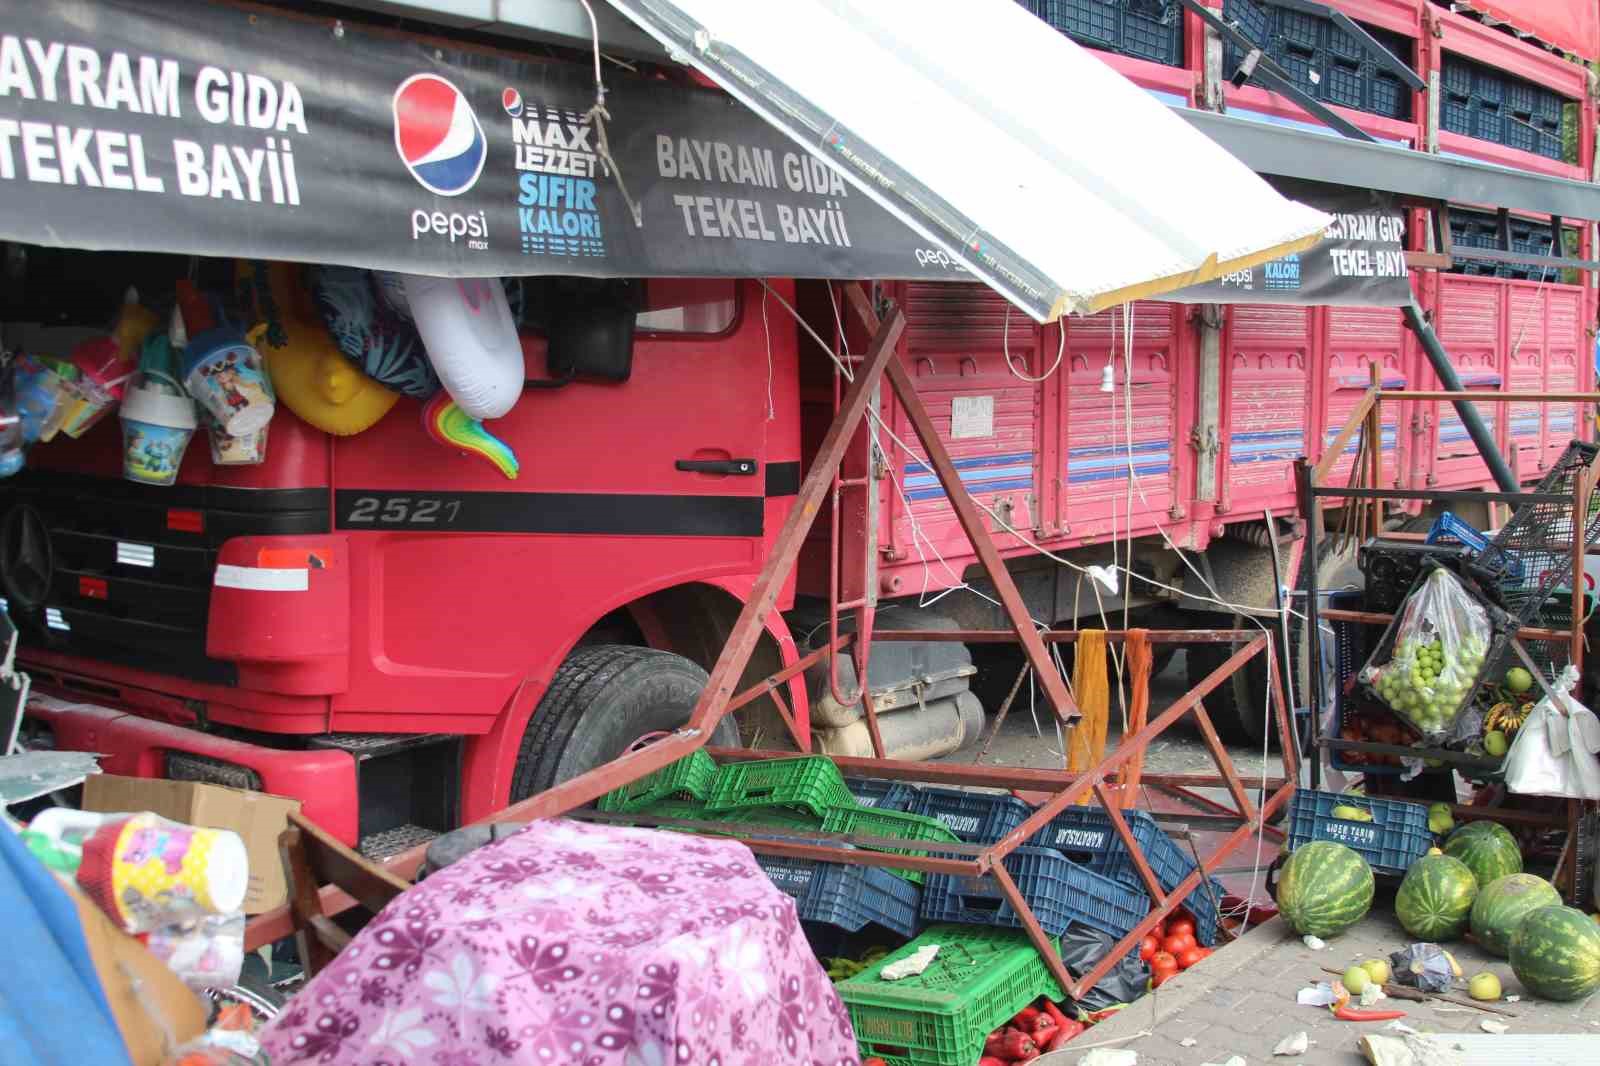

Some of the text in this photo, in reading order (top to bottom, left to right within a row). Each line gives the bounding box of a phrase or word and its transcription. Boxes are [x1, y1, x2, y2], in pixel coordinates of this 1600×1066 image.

[194, 66, 308, 134] GIDA
[511, 117, 592, 152] MAX
[0, 118, 165, 193] TEKEL
[515, 145, 597, 178] LEZZET
[656, 134, 778, 189] BAYRAM
[783, 152, 848, 197] GIDA
[519, 173, 597, 211] SIFIR
[411, 209, 488, 242] pepsi
[673, 195, 776, 241] TEKEL
[468, 239, 488, 250] max
[1329, 249, 1373, 276] TEKEL
[347, 497, 461, 522] 2521
